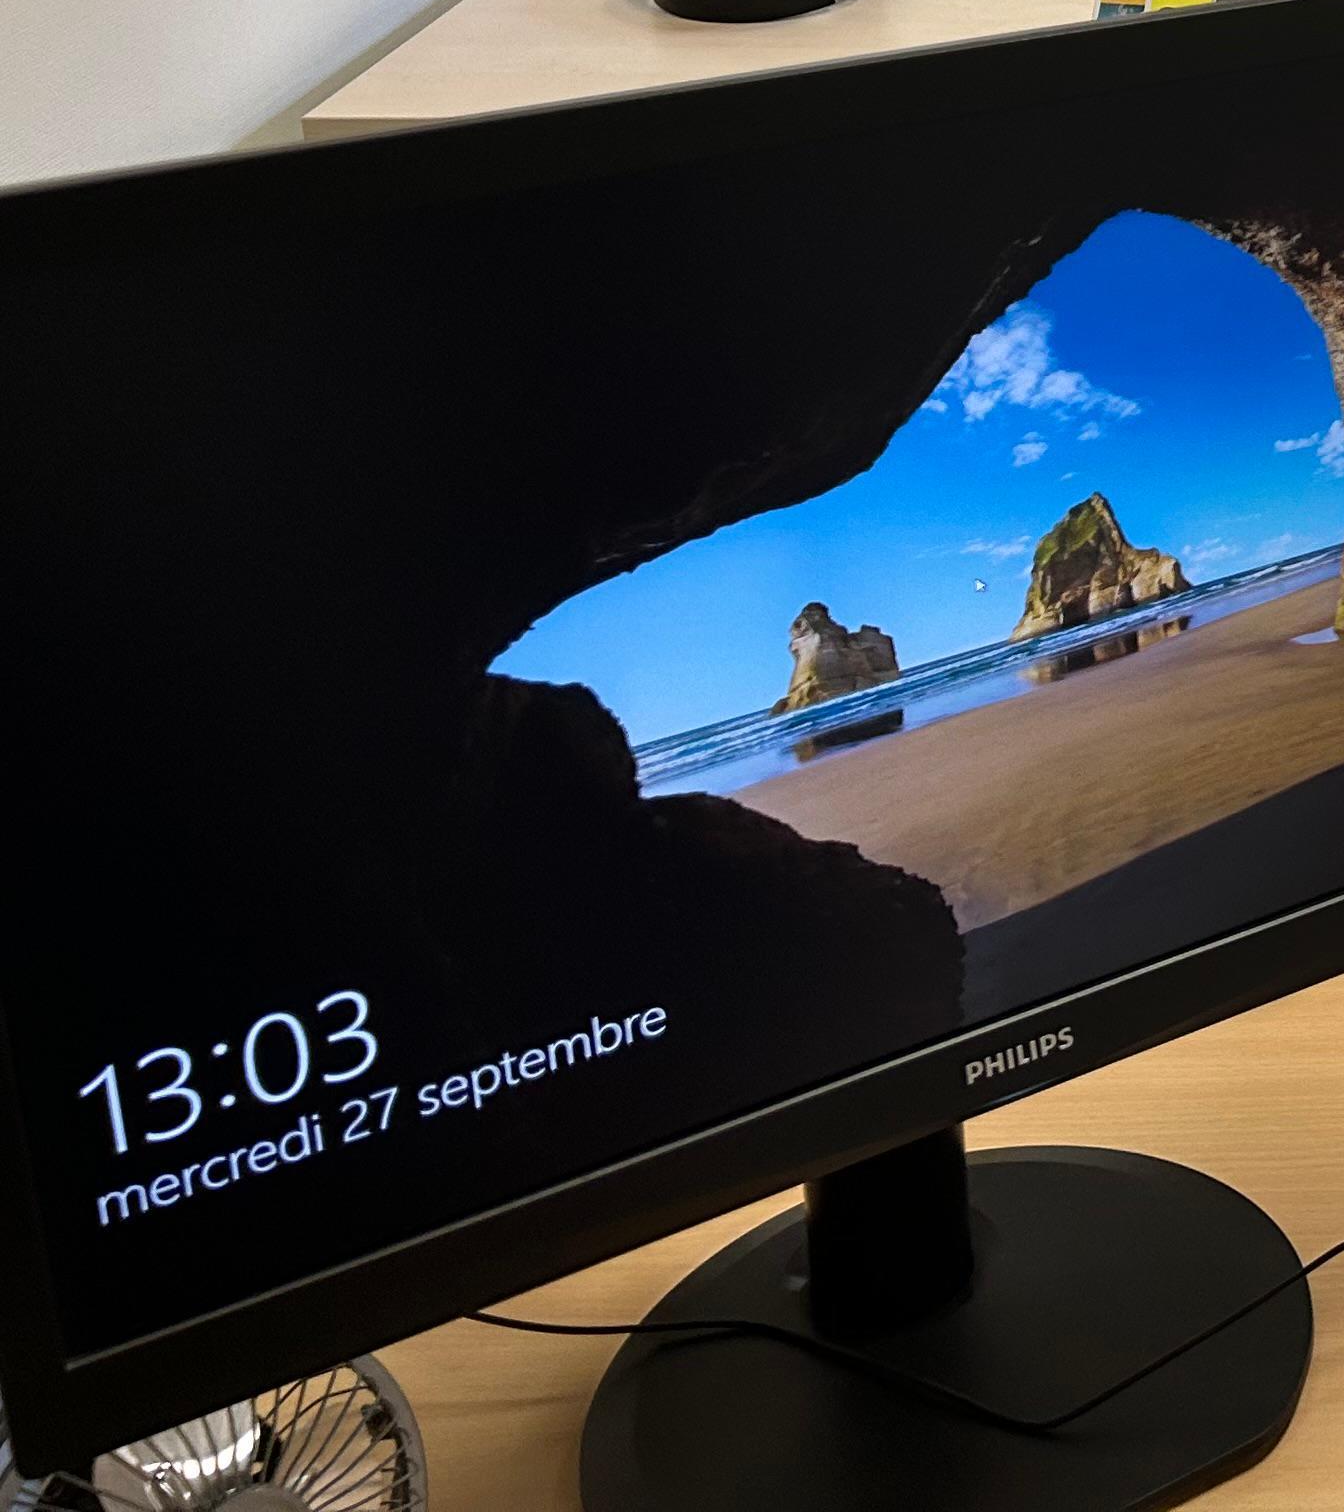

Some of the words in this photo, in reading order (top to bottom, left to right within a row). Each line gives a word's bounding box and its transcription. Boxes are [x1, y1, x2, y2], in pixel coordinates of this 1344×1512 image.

[79, 990, 379, 1155] 13:03
[97, 1114, 325, 1227] mercredi
[341, 1087, 399, 1144] 27
[418, 1004, 669, 1118] septembre
[964, 1026, 1075, 1085] PHILIPS
